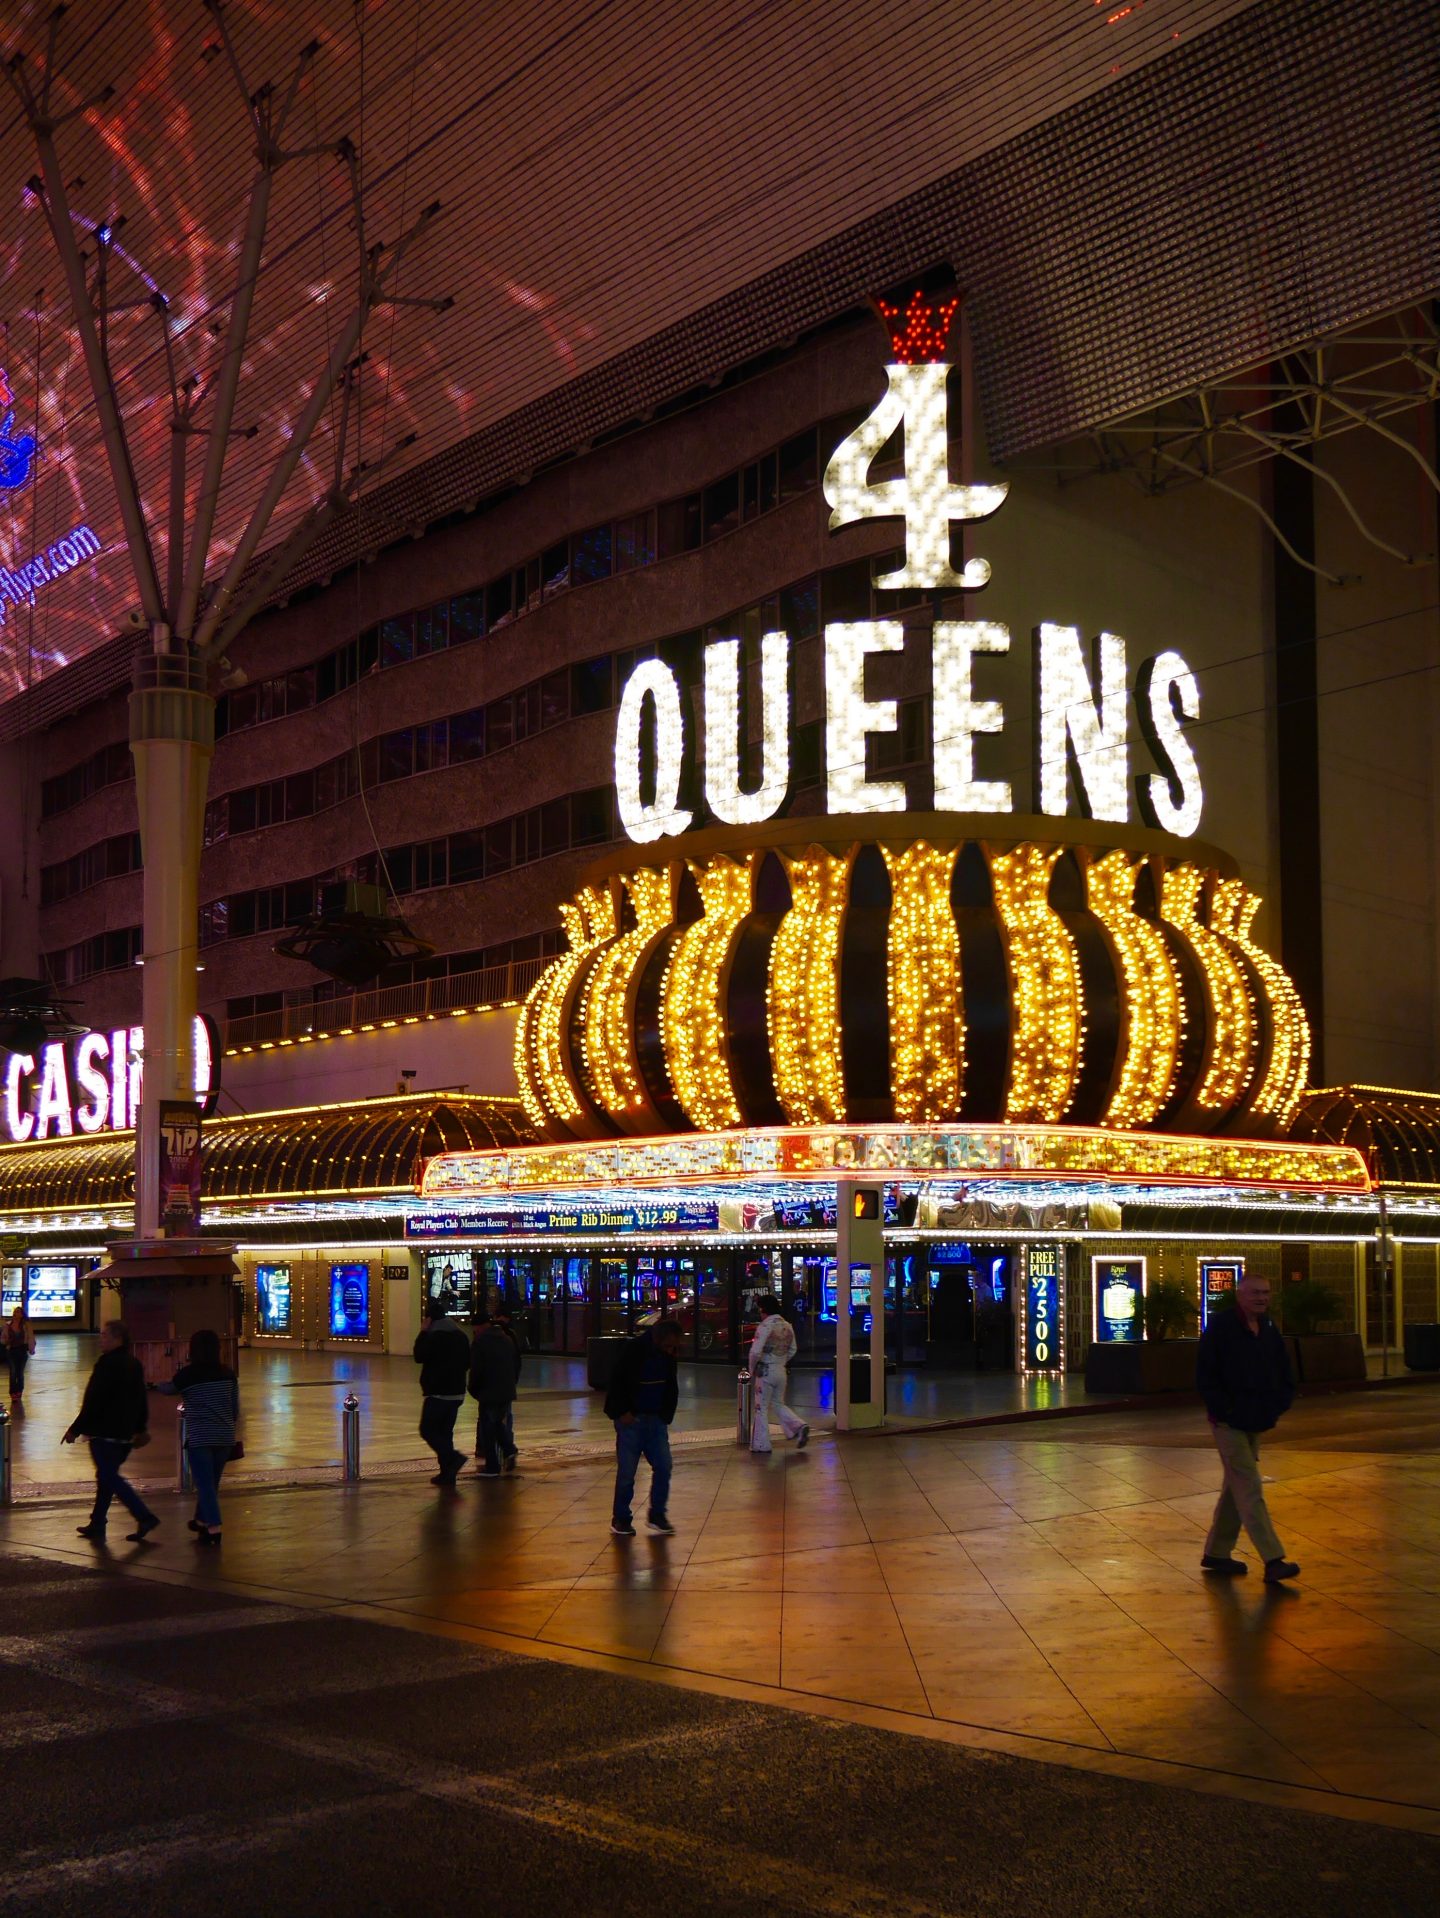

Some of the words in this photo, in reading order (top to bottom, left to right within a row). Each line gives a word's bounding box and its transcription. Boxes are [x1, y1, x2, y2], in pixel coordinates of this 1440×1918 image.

[823, 364, 1010, 589] 4
[614, 621, 1203, 844] QUEENS
[410, 1220, 425, 1231] Royal
[426, 1219, 444, 1231] Players
[444, 1218, 459, 1228] Club
[460, 1218, 487, 1228] Members
[487, 1217, 508, 1227] Receive
[549, 1214, 577, 1227] Prime
[581, 1213, 598, 1226] Rib
[600, 1212, 633, 1226] Dinner
[637, 1209, 677, 1226] $12.99
[1030, 1251, 1055, 1264] FREE
[1029, 1264, 1056, 1277] PULL
